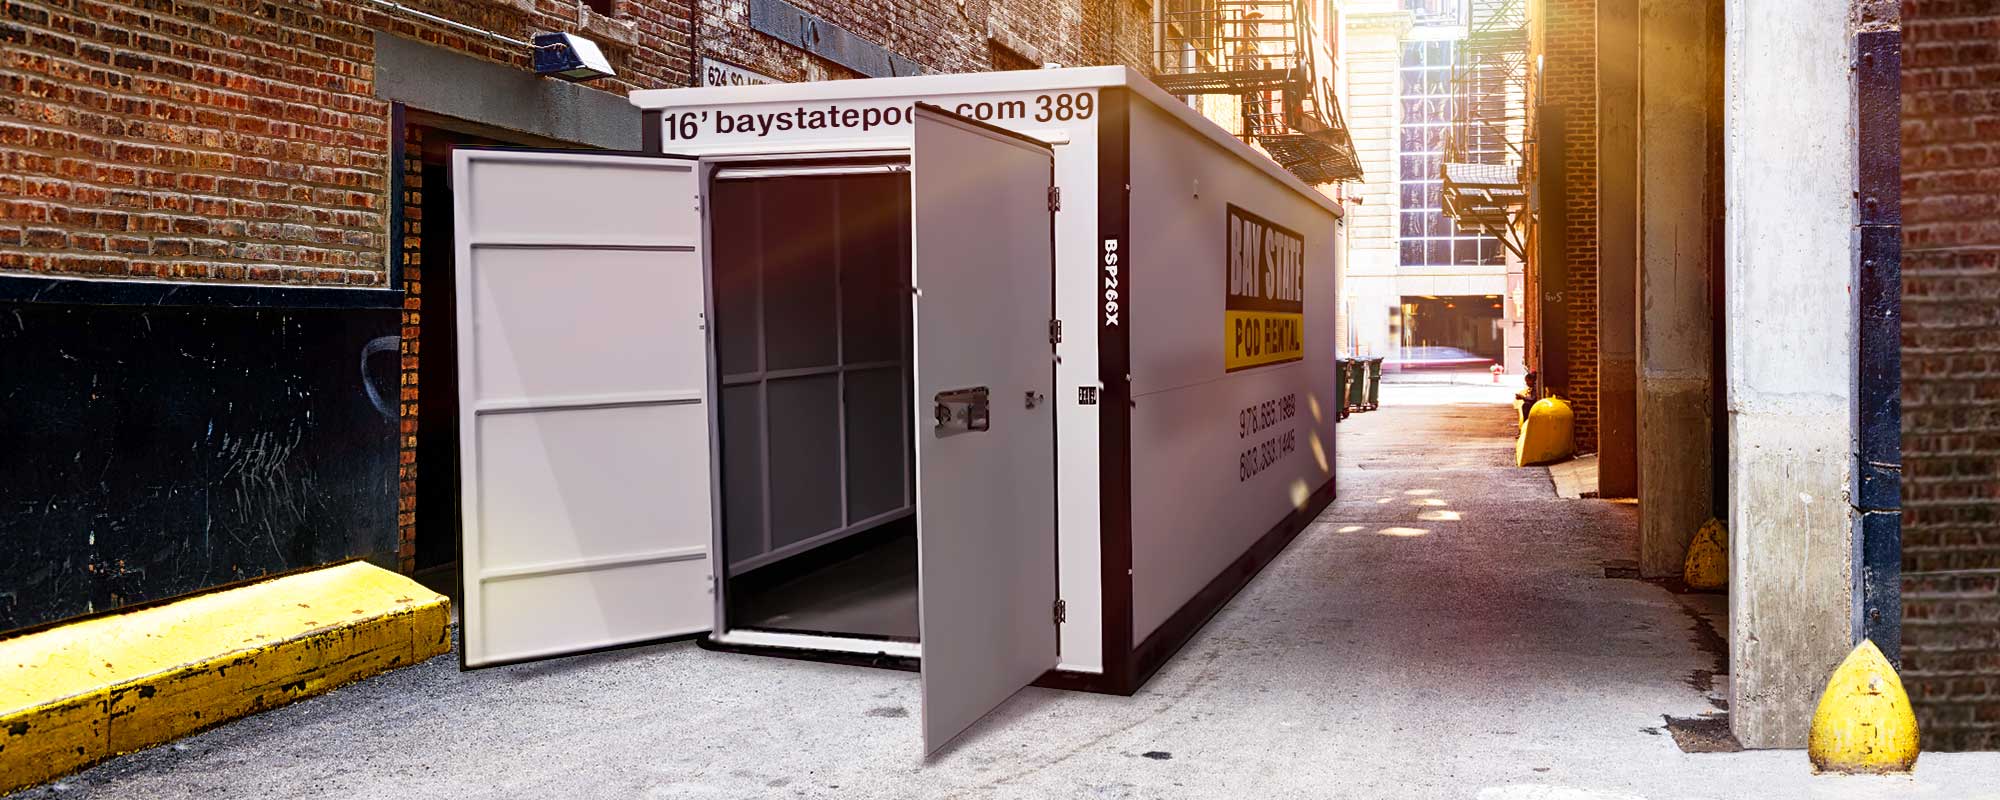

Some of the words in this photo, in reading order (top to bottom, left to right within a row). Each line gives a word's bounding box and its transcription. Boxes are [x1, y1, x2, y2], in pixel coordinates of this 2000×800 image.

[708, 66, 727, 87] 624
[1034, 92, 1095, 123] 389
[1230, 213, 1262, 298] BAY
[1264, 227, 1302, 302] STATE
[1104, 239, 1119, 326] BSP266X
[1235, 318, 1260, 359] POD
[1264, 318, 1300, 356] RENTAL
